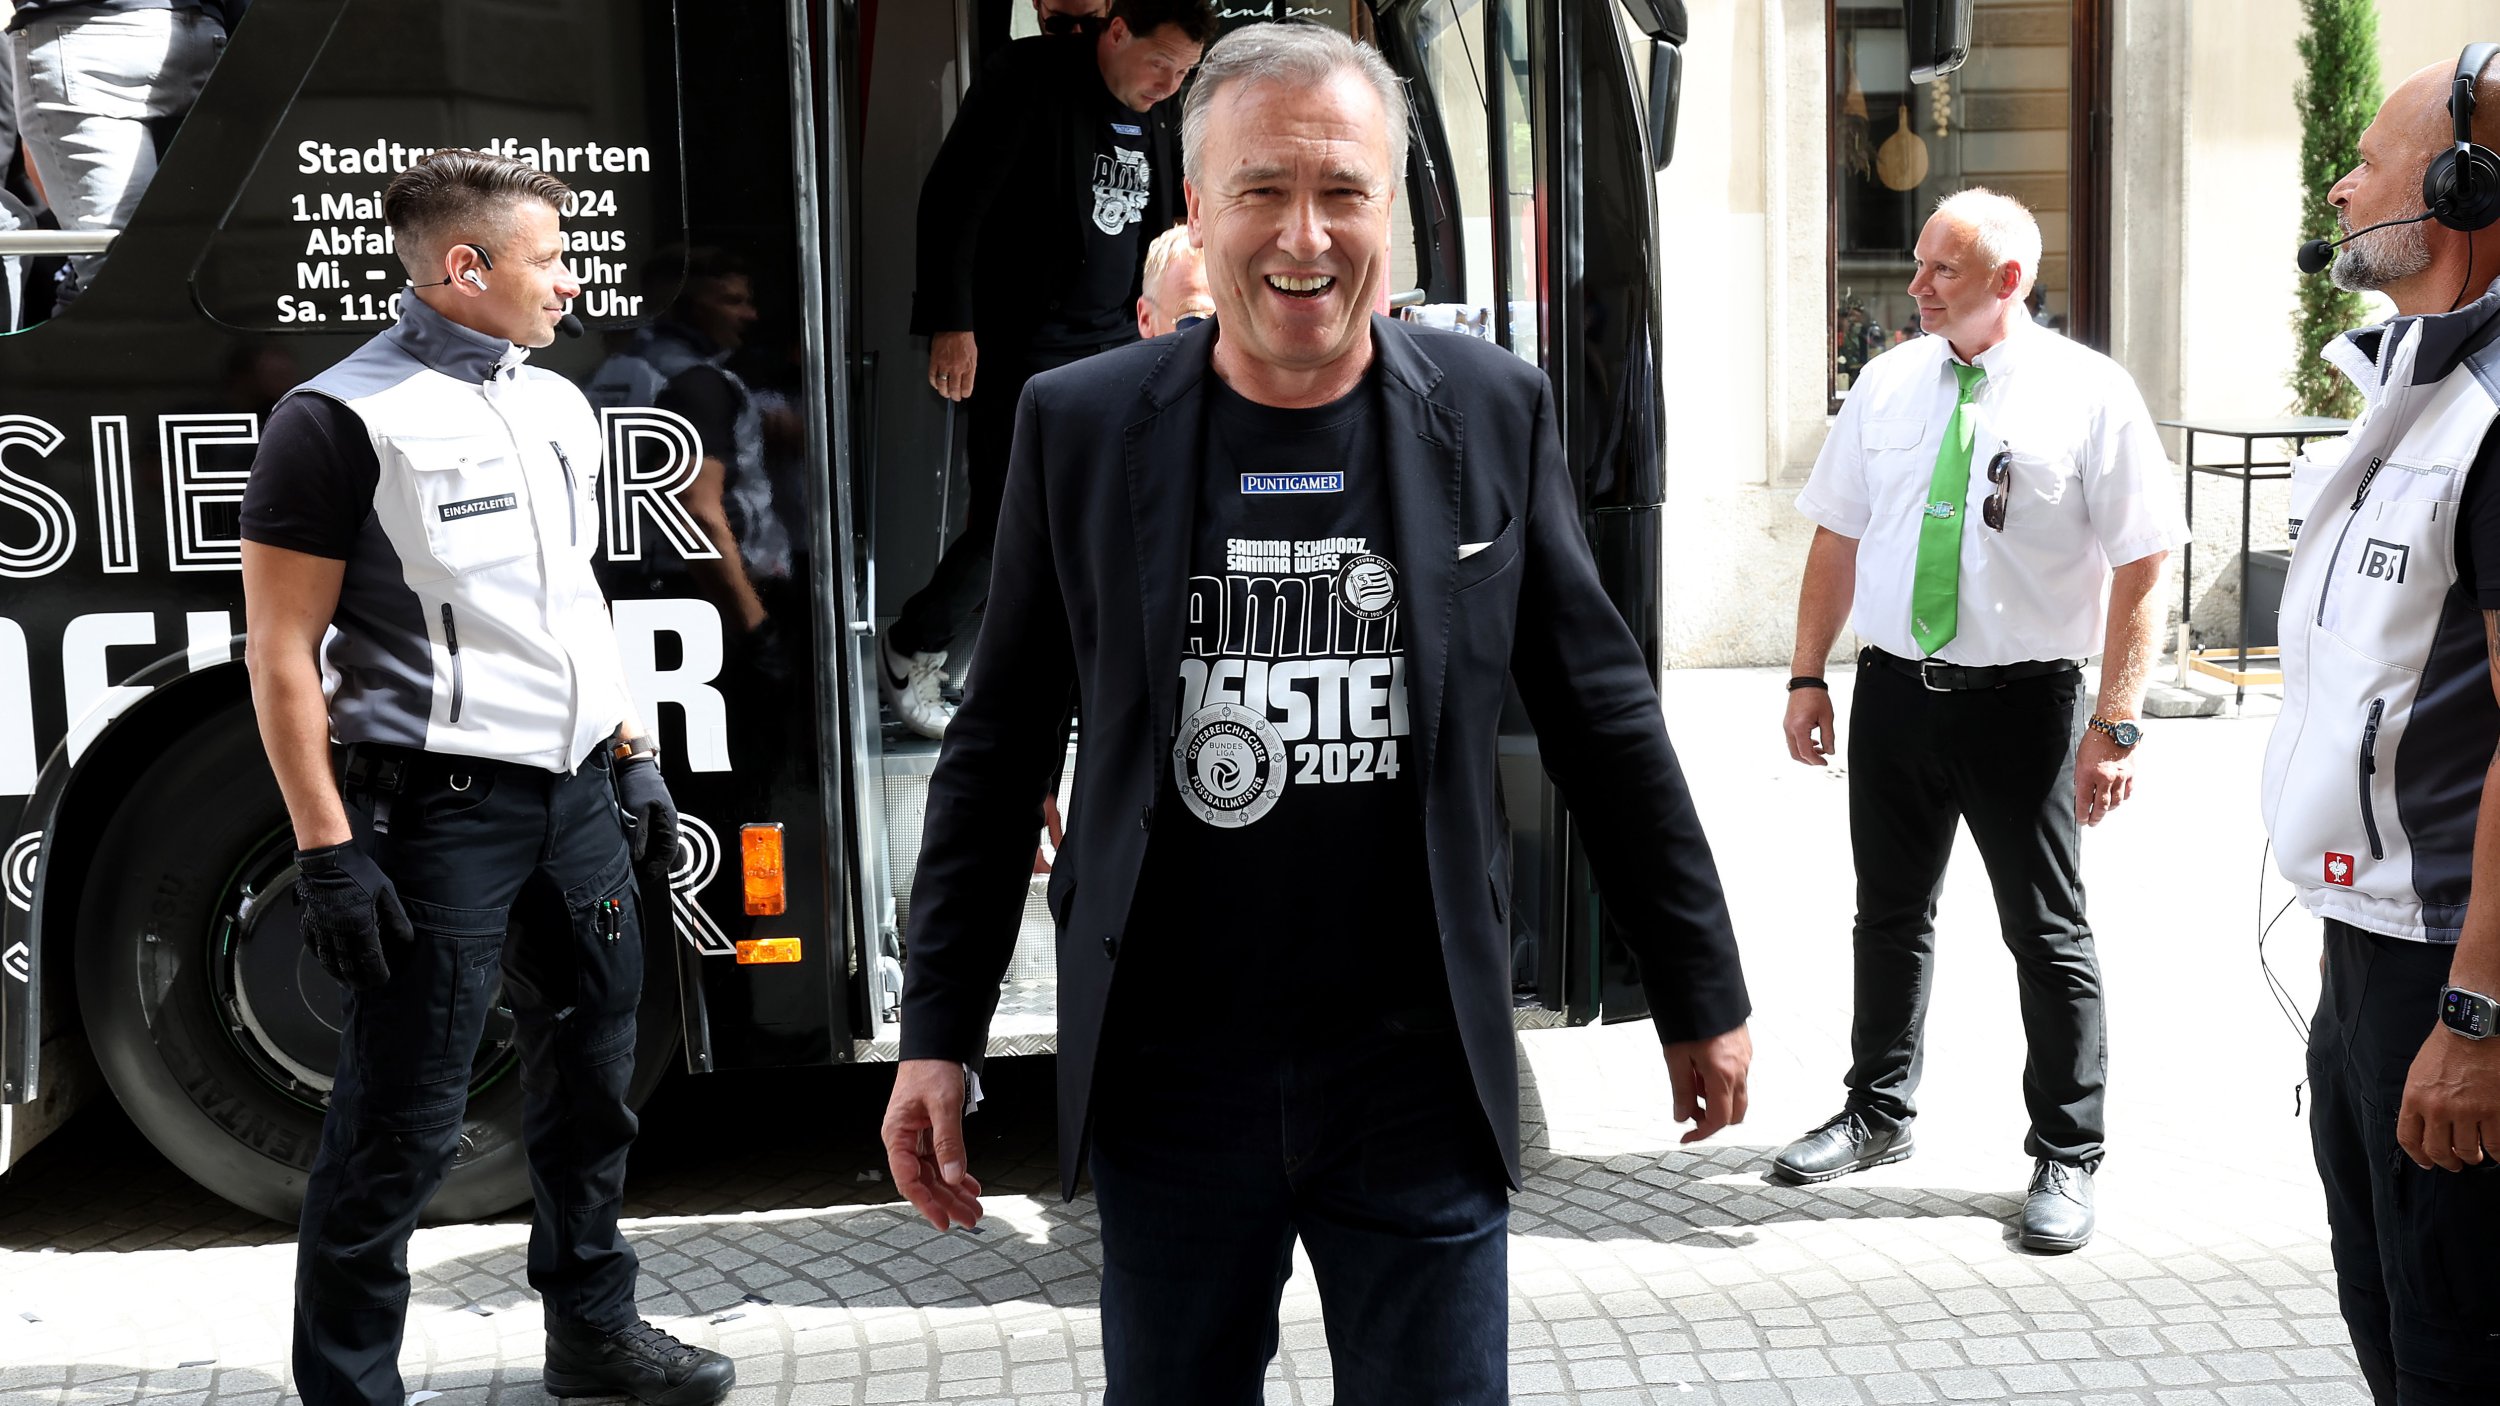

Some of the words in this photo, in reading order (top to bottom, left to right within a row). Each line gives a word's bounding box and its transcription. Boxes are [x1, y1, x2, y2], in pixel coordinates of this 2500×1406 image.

[291, 190, 384, 222] 1.Mai
[559, 189, 618, 218] 024
[296, 260, 350, 289] Mi.
[569, 255, 628, 285] Uhr
[276, 294, 327, 323] Sa.
[585, 288, 644, 317] Uhr
[1247, 475, 1338, 491] PUNTIGAMER
[443, 496, 516, 518] EINSATZLEITER
[1226, 538, 1291, 557] SAMMA
[1226, 555, 1291, 574] SAMMA
[1294, 553, 1341, 573] WEISS
[1355, 557, 1375, 565] STURM
[1376, 559, 1391, 571] GRAZ
[1356, 609, 1369, 618] SEIT
[1188, 723, 1267, 764] ÖSTERREICHISCHER
[1208, 742, 1243, 750] BUNDES
[1216, 749, 1236, 757] LIGA
[1295, 740, 1400, 784] 2024
[1190, 775, 1266, 809] FUSSBALLMEISTER
